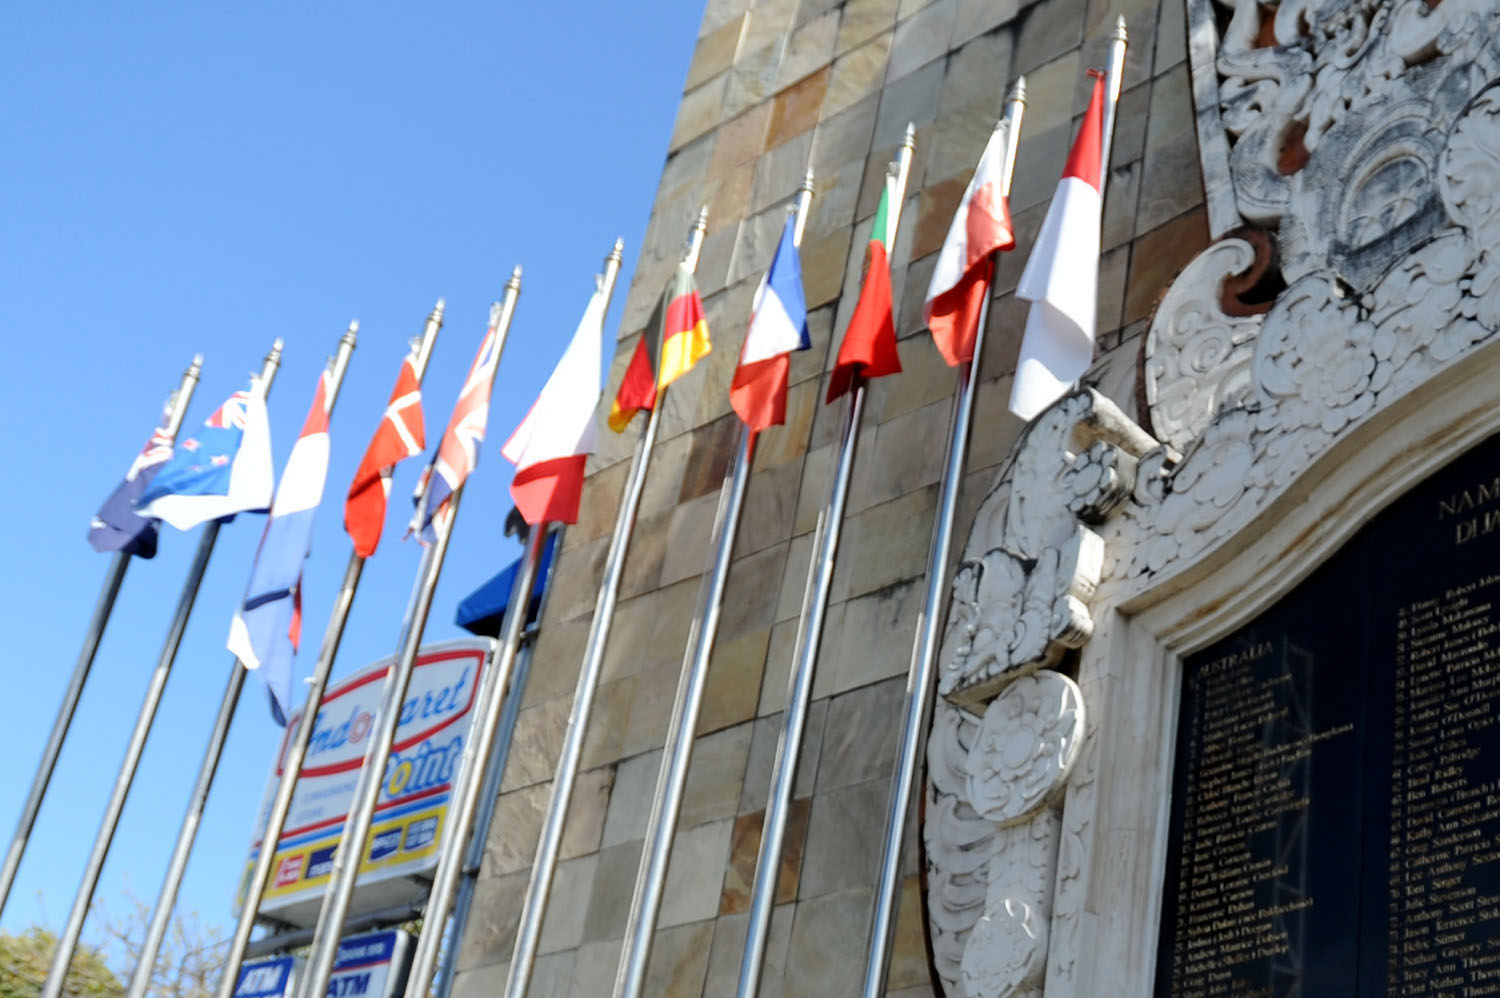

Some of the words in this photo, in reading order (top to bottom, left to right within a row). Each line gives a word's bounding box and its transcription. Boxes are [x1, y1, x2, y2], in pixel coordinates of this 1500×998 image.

[310, 666, 470, 755] Indoaret
[236, 965, 283, 995] ATM
[328, 972, 371, 998] ATM
